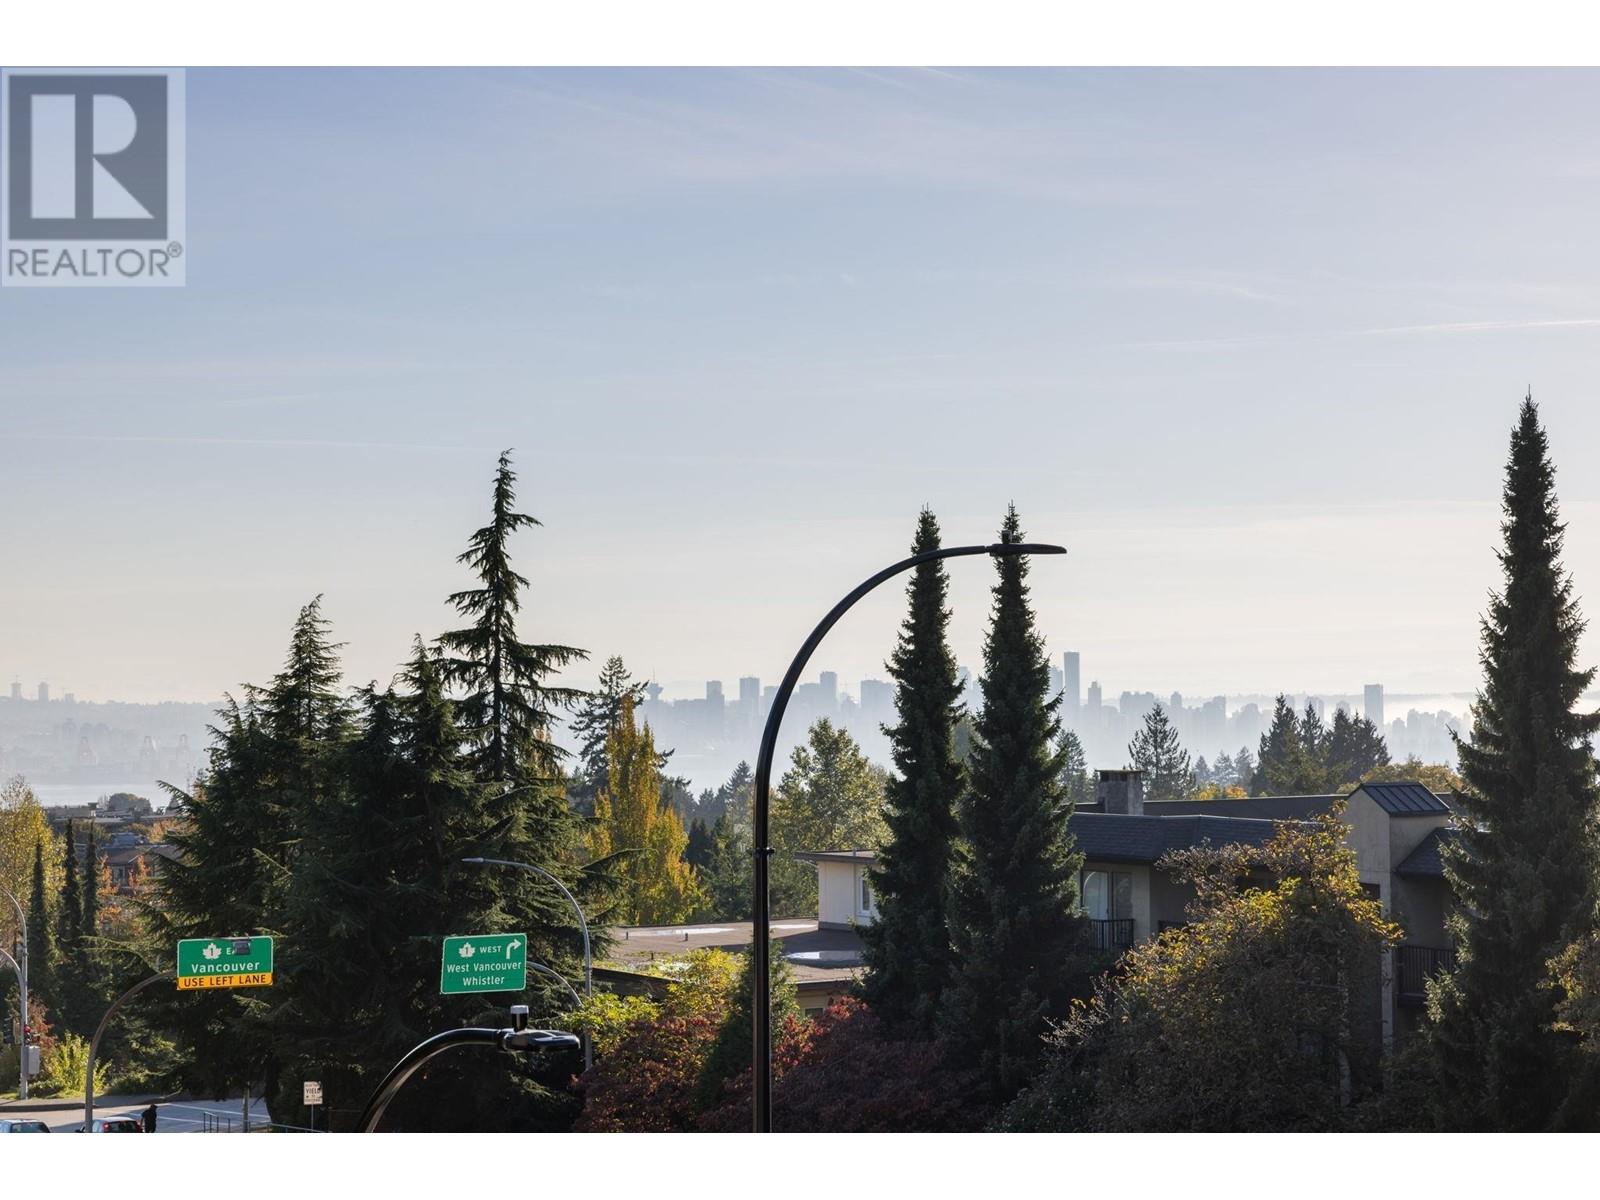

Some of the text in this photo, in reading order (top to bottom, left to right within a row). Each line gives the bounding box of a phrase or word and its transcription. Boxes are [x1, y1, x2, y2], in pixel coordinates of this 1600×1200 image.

[191, 962, 260, 974] Vancouver
[447, 962, 522, 973] West Vancouver
[184, 974, 266, 988] USE LEFT LANE
[463, 976, 505, 986] Whistler
